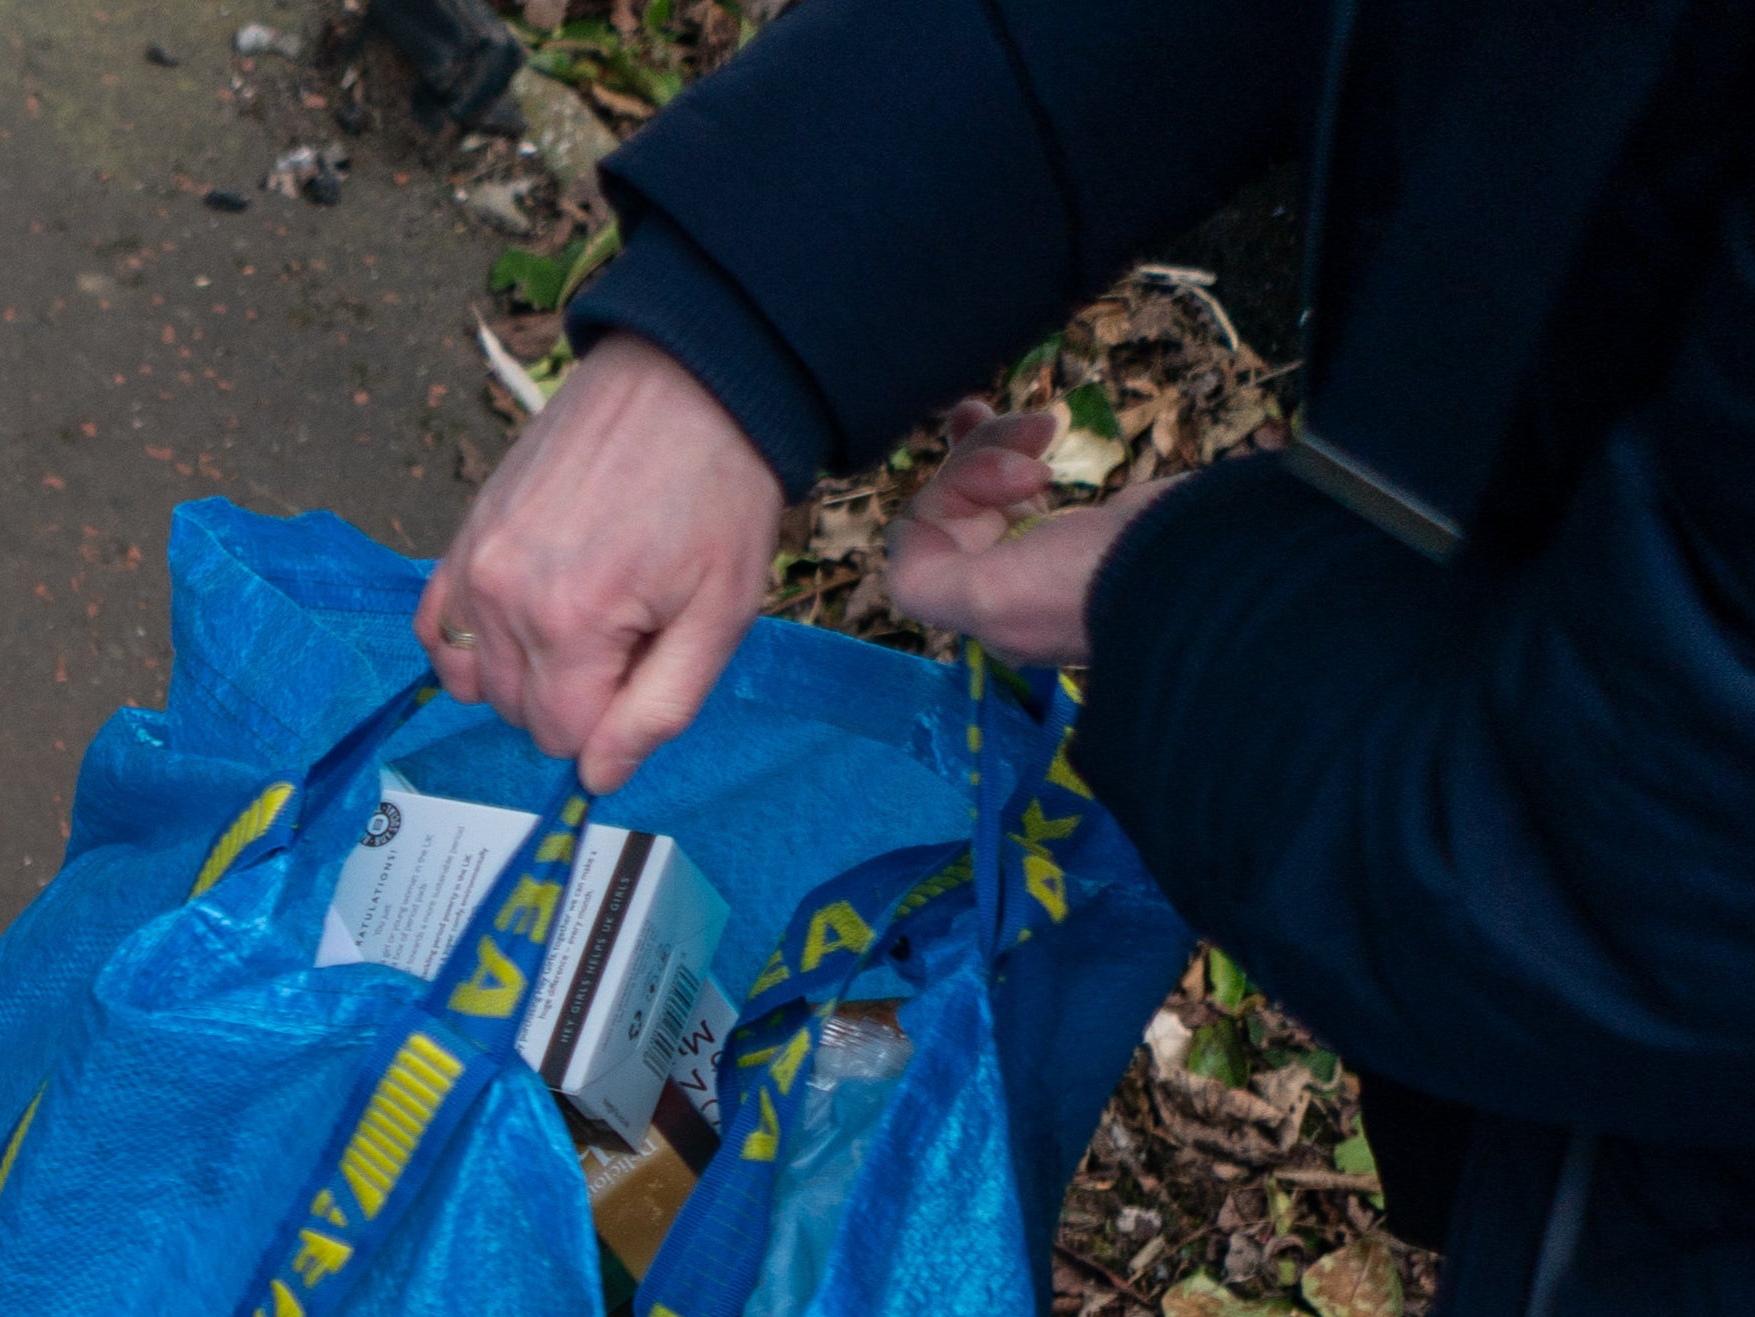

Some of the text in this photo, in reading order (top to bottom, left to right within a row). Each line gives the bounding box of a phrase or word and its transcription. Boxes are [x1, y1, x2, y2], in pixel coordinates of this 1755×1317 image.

[354, 848, 399, 947] RATULATIONS!
[569, 976, 592, 1015] GIRLS
[584, 936, 607, 975] HELPS
[608, 875, 630, 911] GIRLS
